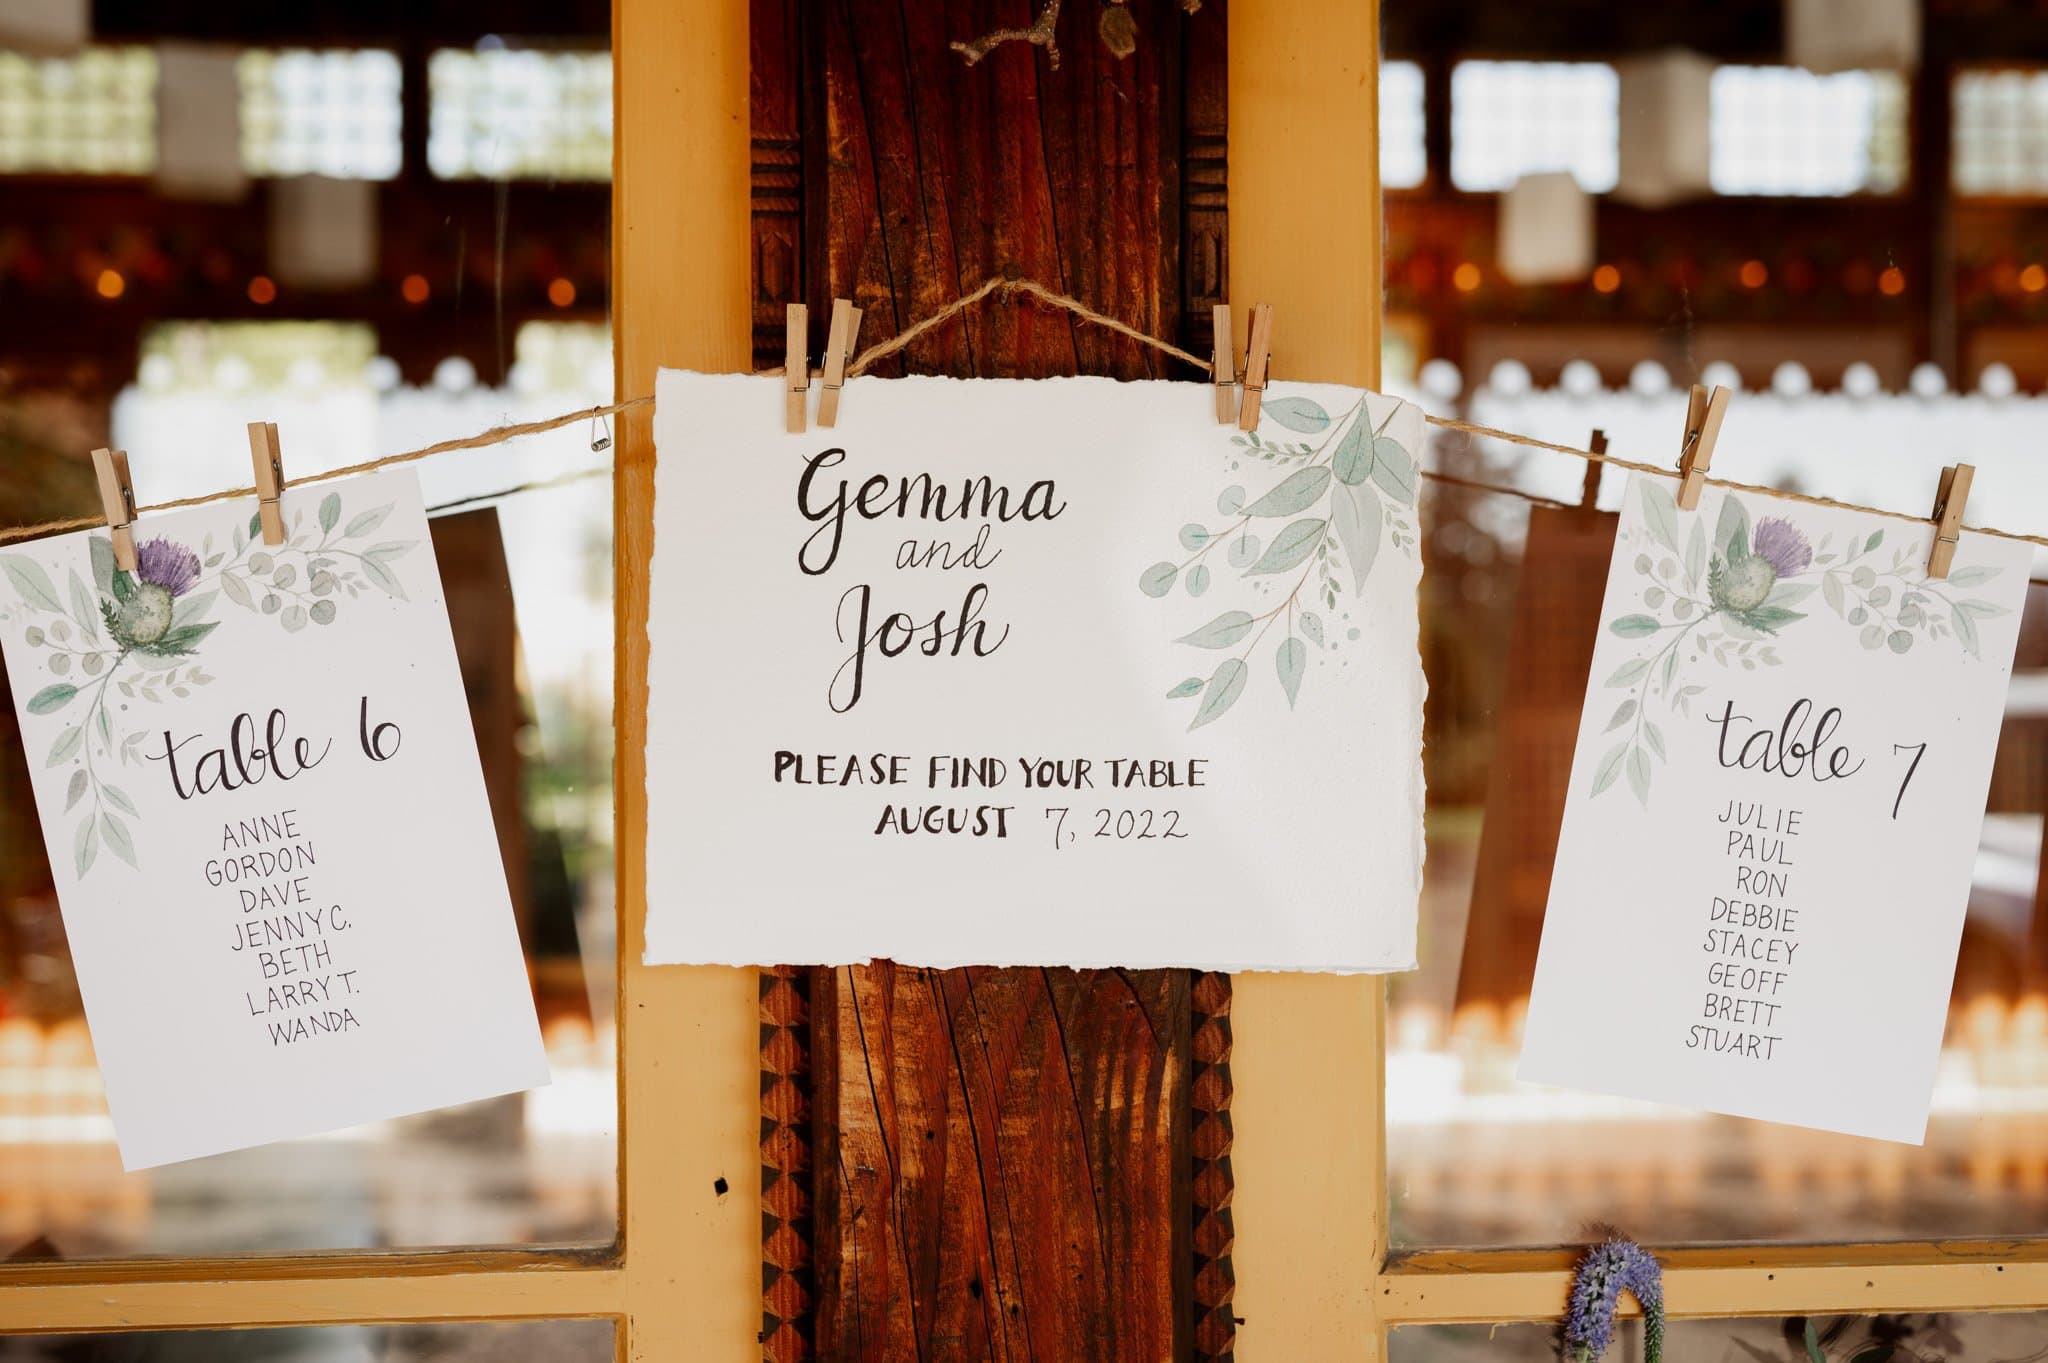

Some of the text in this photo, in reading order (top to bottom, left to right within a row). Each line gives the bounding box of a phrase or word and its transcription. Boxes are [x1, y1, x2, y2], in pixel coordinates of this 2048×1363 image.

[798, 448, 1067, 576] Gemma
[896, 524, 1002, 570] and
[829, 583, 1009, 713] Josh
[145, 696, 401, 800] table 6
[1706, 698, 1927, 820] table 7
[775, 751, 1209, 789] PLEASE FIND YOUR TABLE
[223, 810, 301, 851] ANNE
[874, 804, 1188, 850] AUGUST 7, 2022
[1718, 800, 1803, 835] JULIE
[205, 841, 316, 887] GORDON
[1727, 830, 1793, 865] PAUL
[240, 876, 311, 913] DAVE
[1737, 866, 1788, 898] RON
[232, 904, 352, 951] JENNY C.
[1710, 897, 1799, 932] DEBBIE
[259, 940, 332, 979] BETH
[1703, 929, 1799, 965] STACEY
[247, 970, 360, 1016] LARRY T.
[1708, 963, 1788, 995] GEOFF
[268, 1008, 360, 1046] WANDA
[1704, 993, 1782, 1026] BRETT
[1686, 1025, 1783, 1060] STUART
